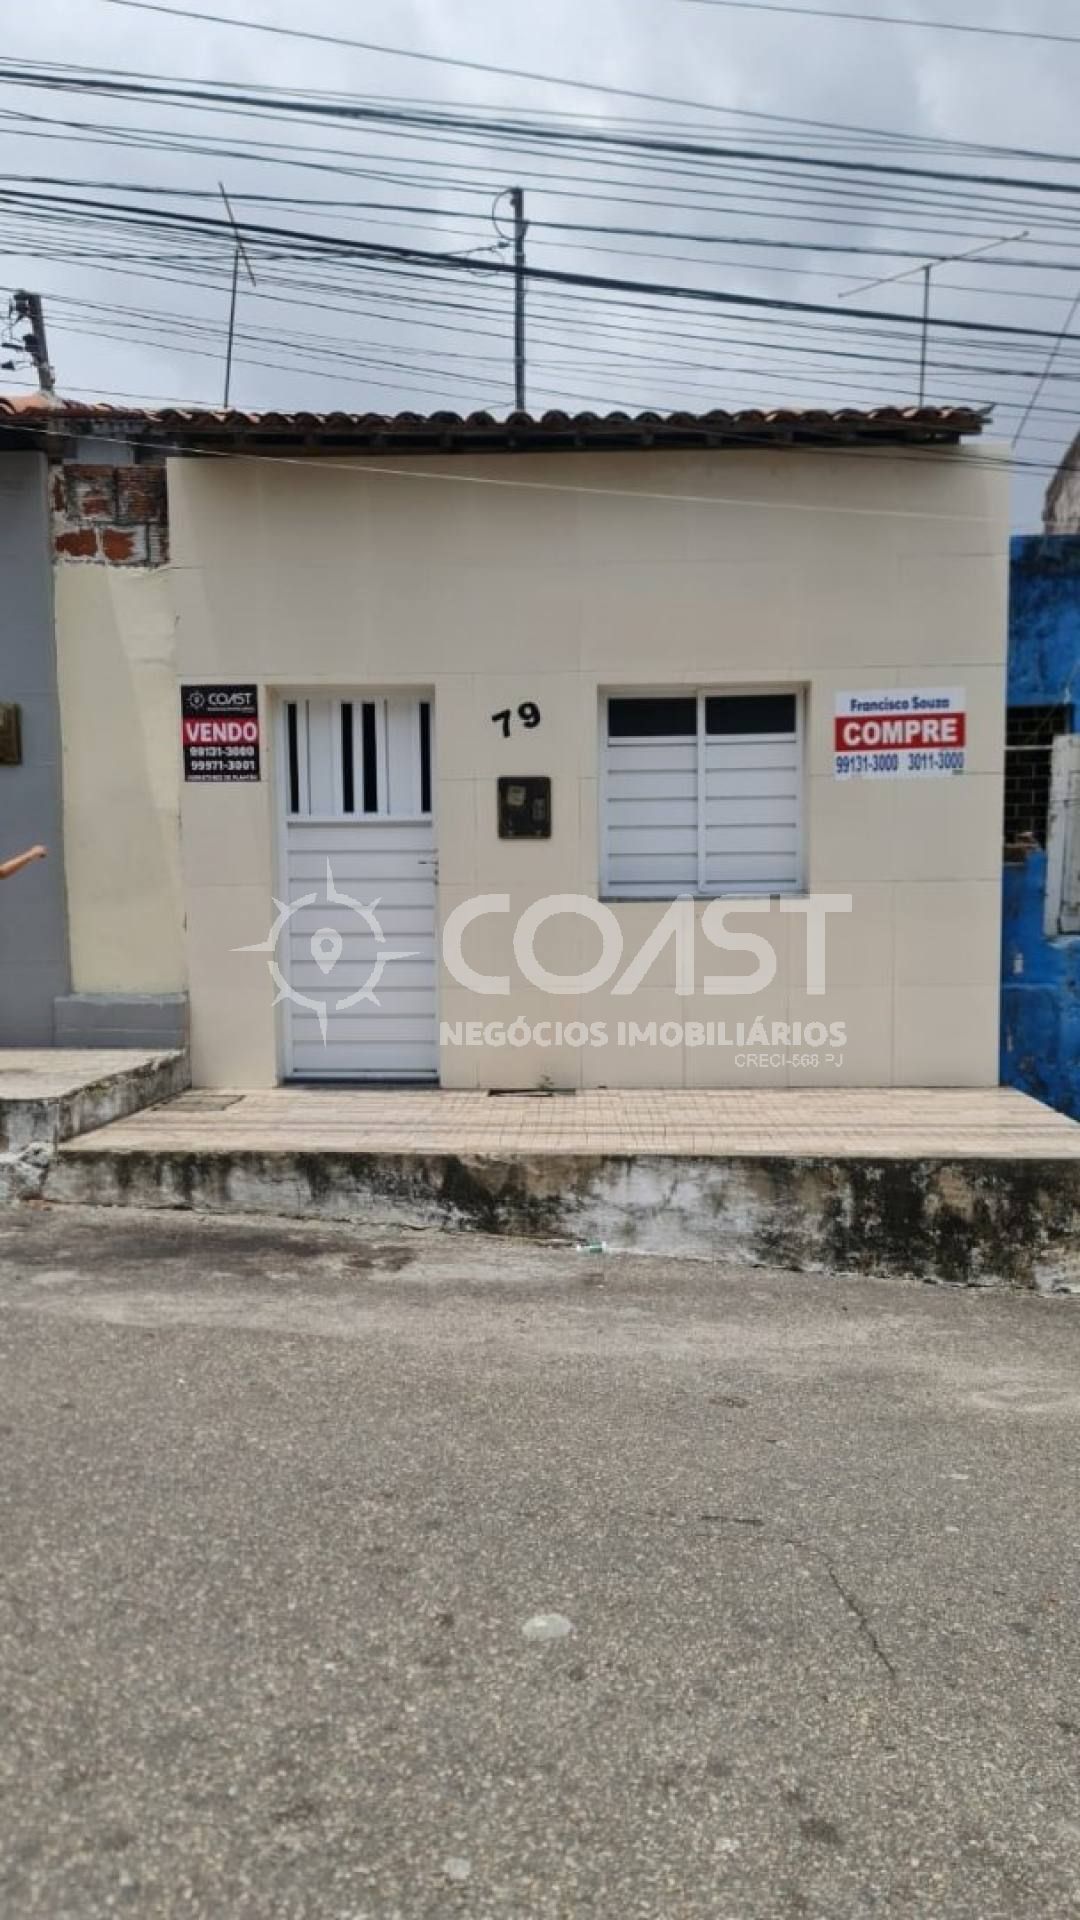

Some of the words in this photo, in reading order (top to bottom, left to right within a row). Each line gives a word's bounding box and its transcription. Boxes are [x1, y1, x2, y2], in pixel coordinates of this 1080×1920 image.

[207, 692, 252, 705] COAST
[849, 697, 909, 712] Francisco
[911, 696, 950, 710] Souza
[491, 701, 541, 738] 79
[185, 721, 257, 743] VENDO
[843, 717, 958, 746] COMPRE
[836, 753, 898, 774] 99131-3000
[908, 751, 964, 771] 3011-3000
